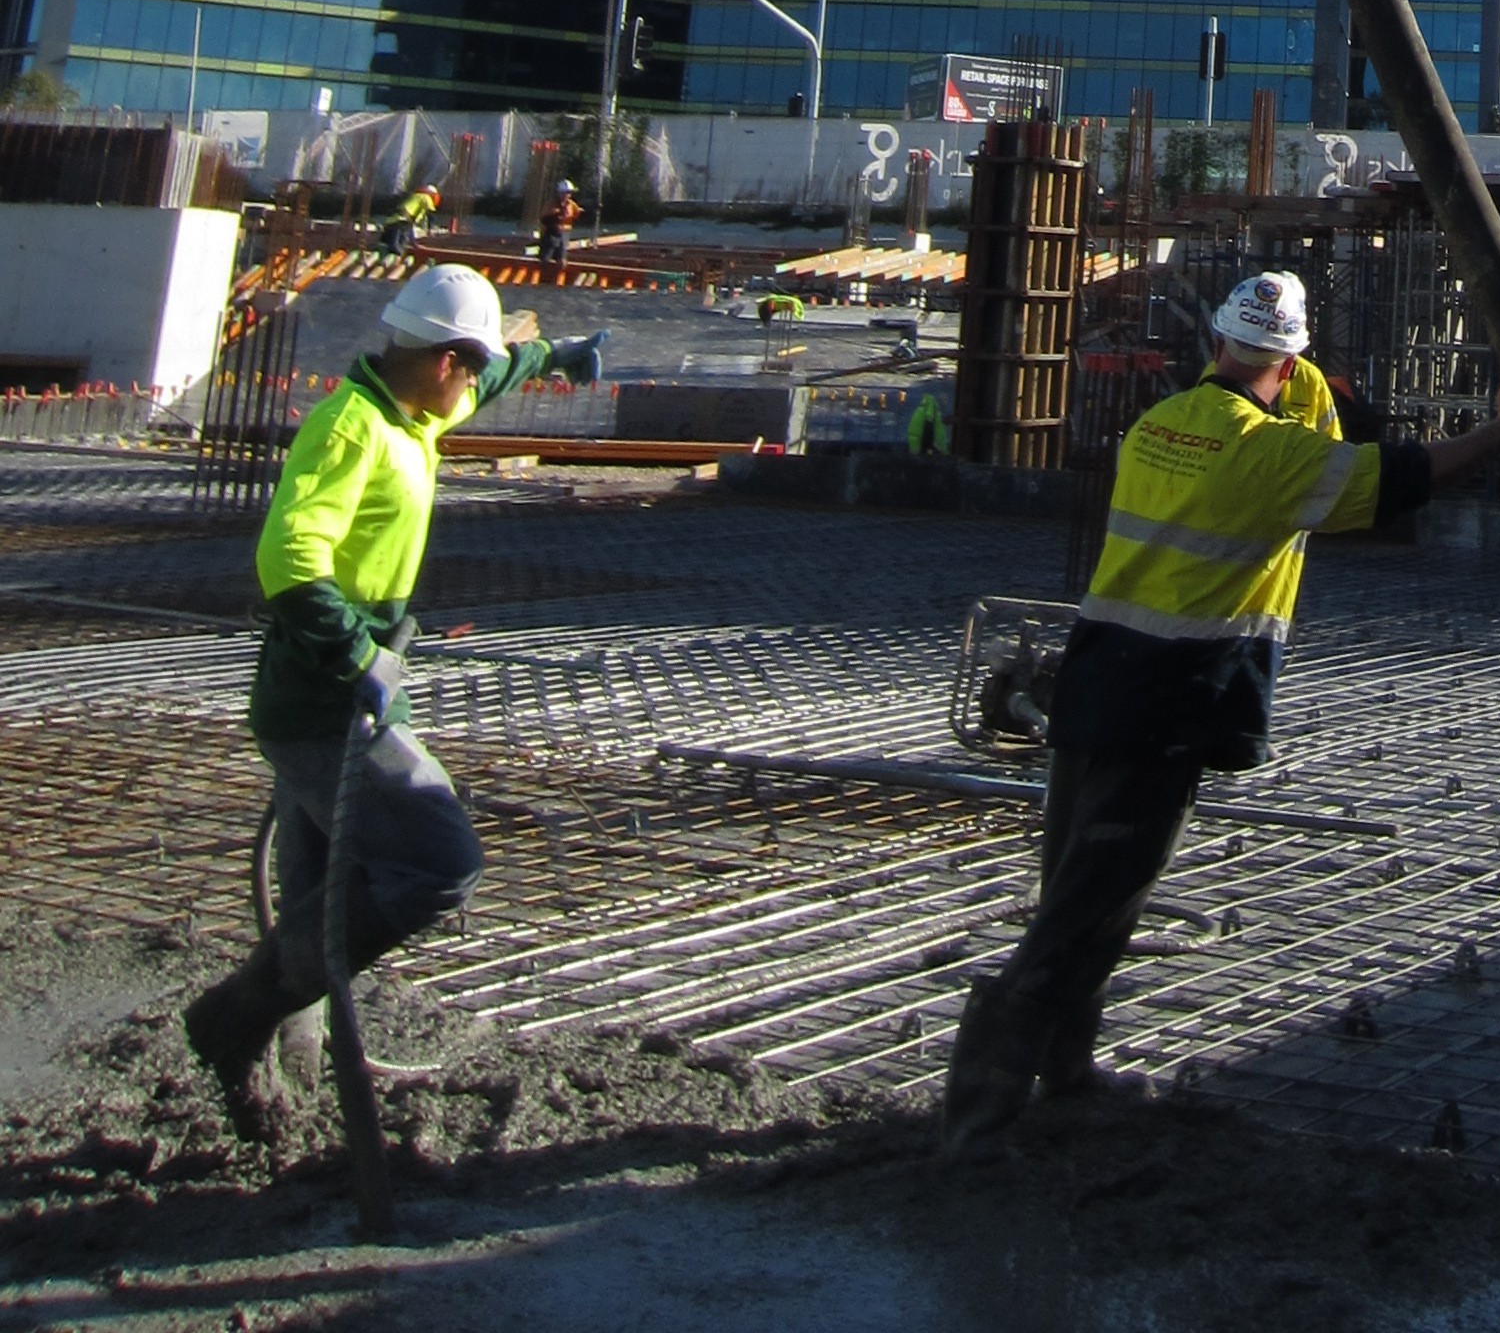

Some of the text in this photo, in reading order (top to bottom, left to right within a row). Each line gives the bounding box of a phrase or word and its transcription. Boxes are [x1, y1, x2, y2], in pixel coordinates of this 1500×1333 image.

[960, 69, 985, 84] RETAIL
[986, 73, 1010, 87] SPACE
[1239, 298, 1287, 321] pump
[1239, 311, 1279, 331] corp
[1138, 420, 1224, 452] pumpcorp
